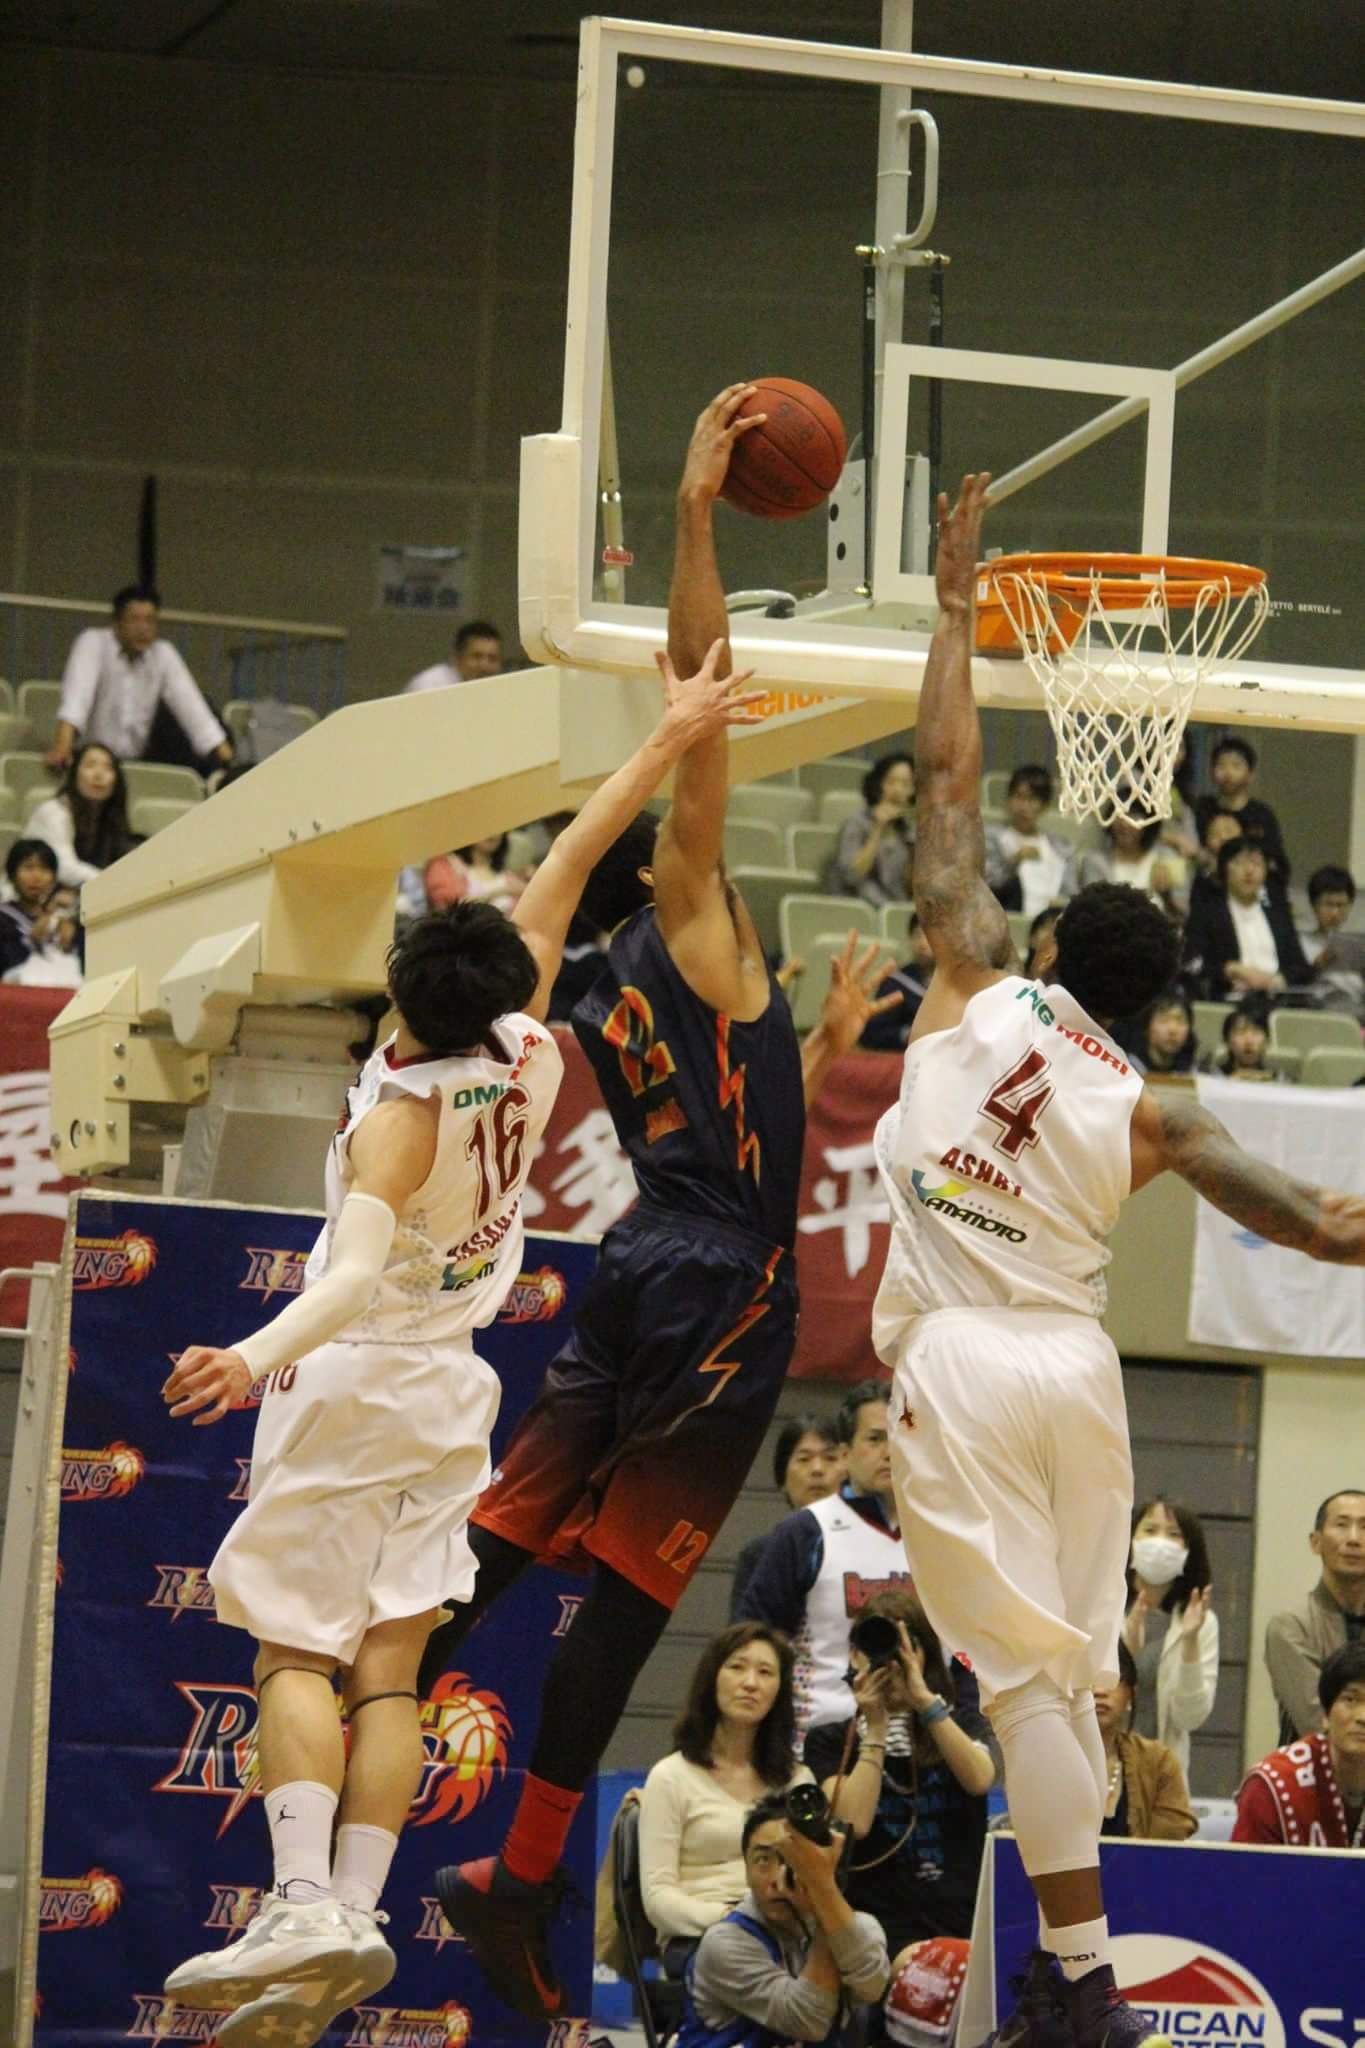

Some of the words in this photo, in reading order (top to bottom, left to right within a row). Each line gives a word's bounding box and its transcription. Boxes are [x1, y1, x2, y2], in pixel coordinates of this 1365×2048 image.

[978, 1044, 1056, 1162] 4
[1055, 1023, 1129, 1077] MORI
[464, 1083, 532, 1226] 16
